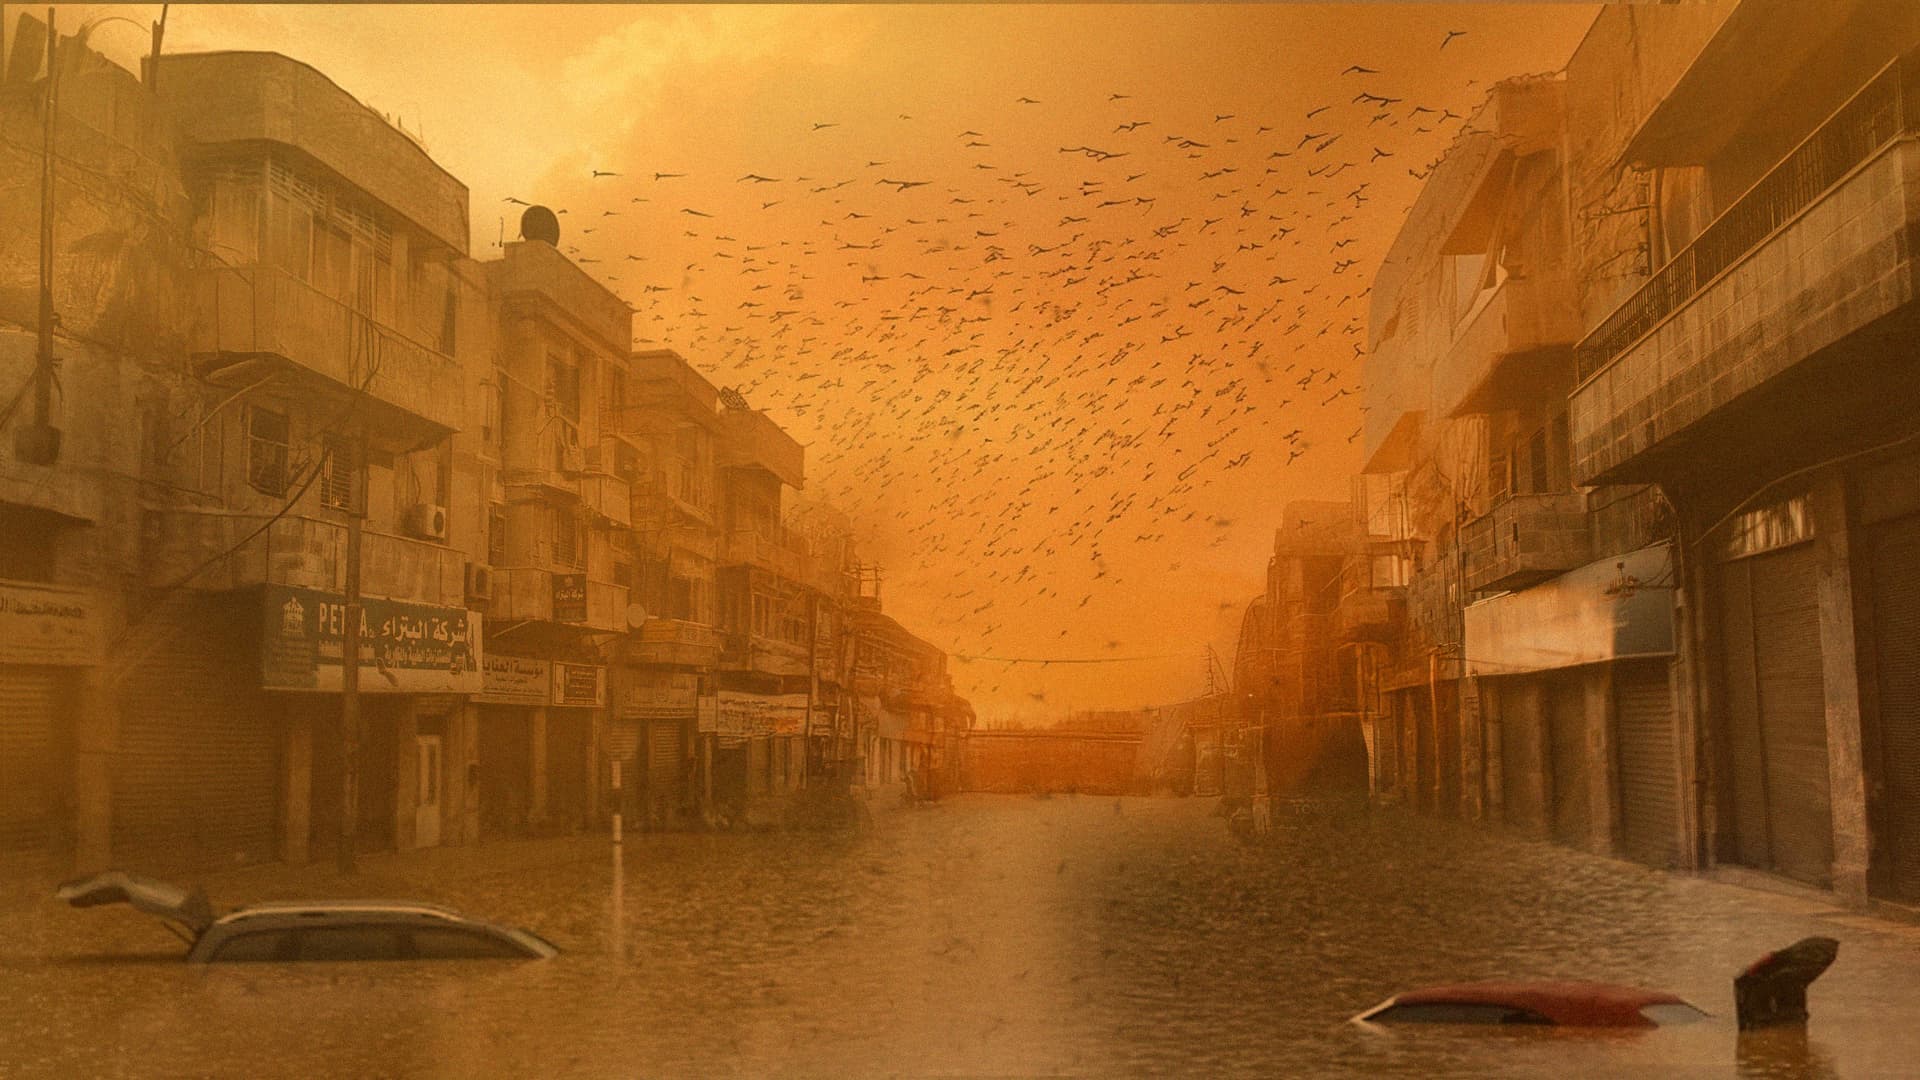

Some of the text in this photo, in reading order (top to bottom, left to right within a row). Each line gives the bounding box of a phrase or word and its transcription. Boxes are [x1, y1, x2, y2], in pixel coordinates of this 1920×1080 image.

[319, 602, 368, 637] PETA
[382, 615, 428, 645] البتراء
[432, 617, 466, 647] شركة
[482, 658, 544, 680] مؤسسة العناي
